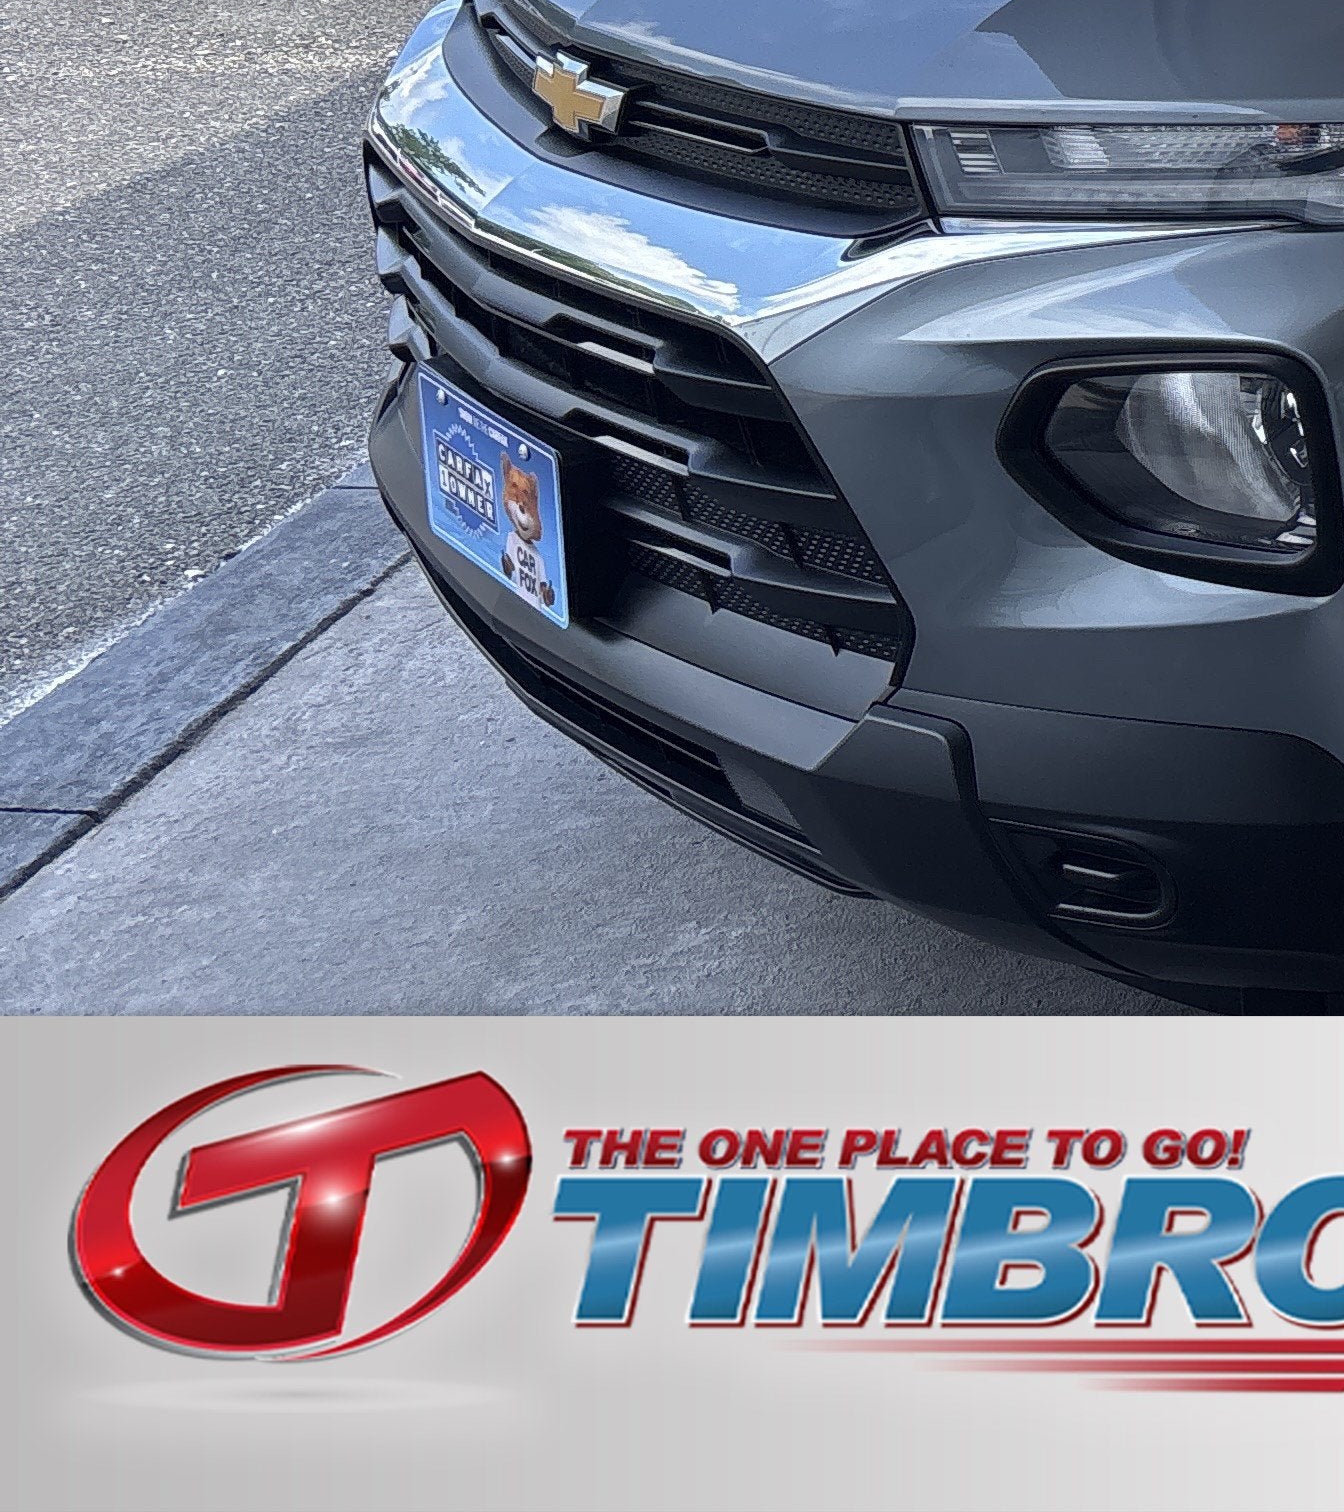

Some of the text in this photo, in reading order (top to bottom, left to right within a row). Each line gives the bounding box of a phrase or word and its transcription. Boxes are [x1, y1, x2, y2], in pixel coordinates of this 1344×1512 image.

[438, 443, 494, 500] CARFAX
[449, 474, 494, 522] OWNER
[516, 545, 536, 572] CAR
[518, 571, 539, 599] FOX
